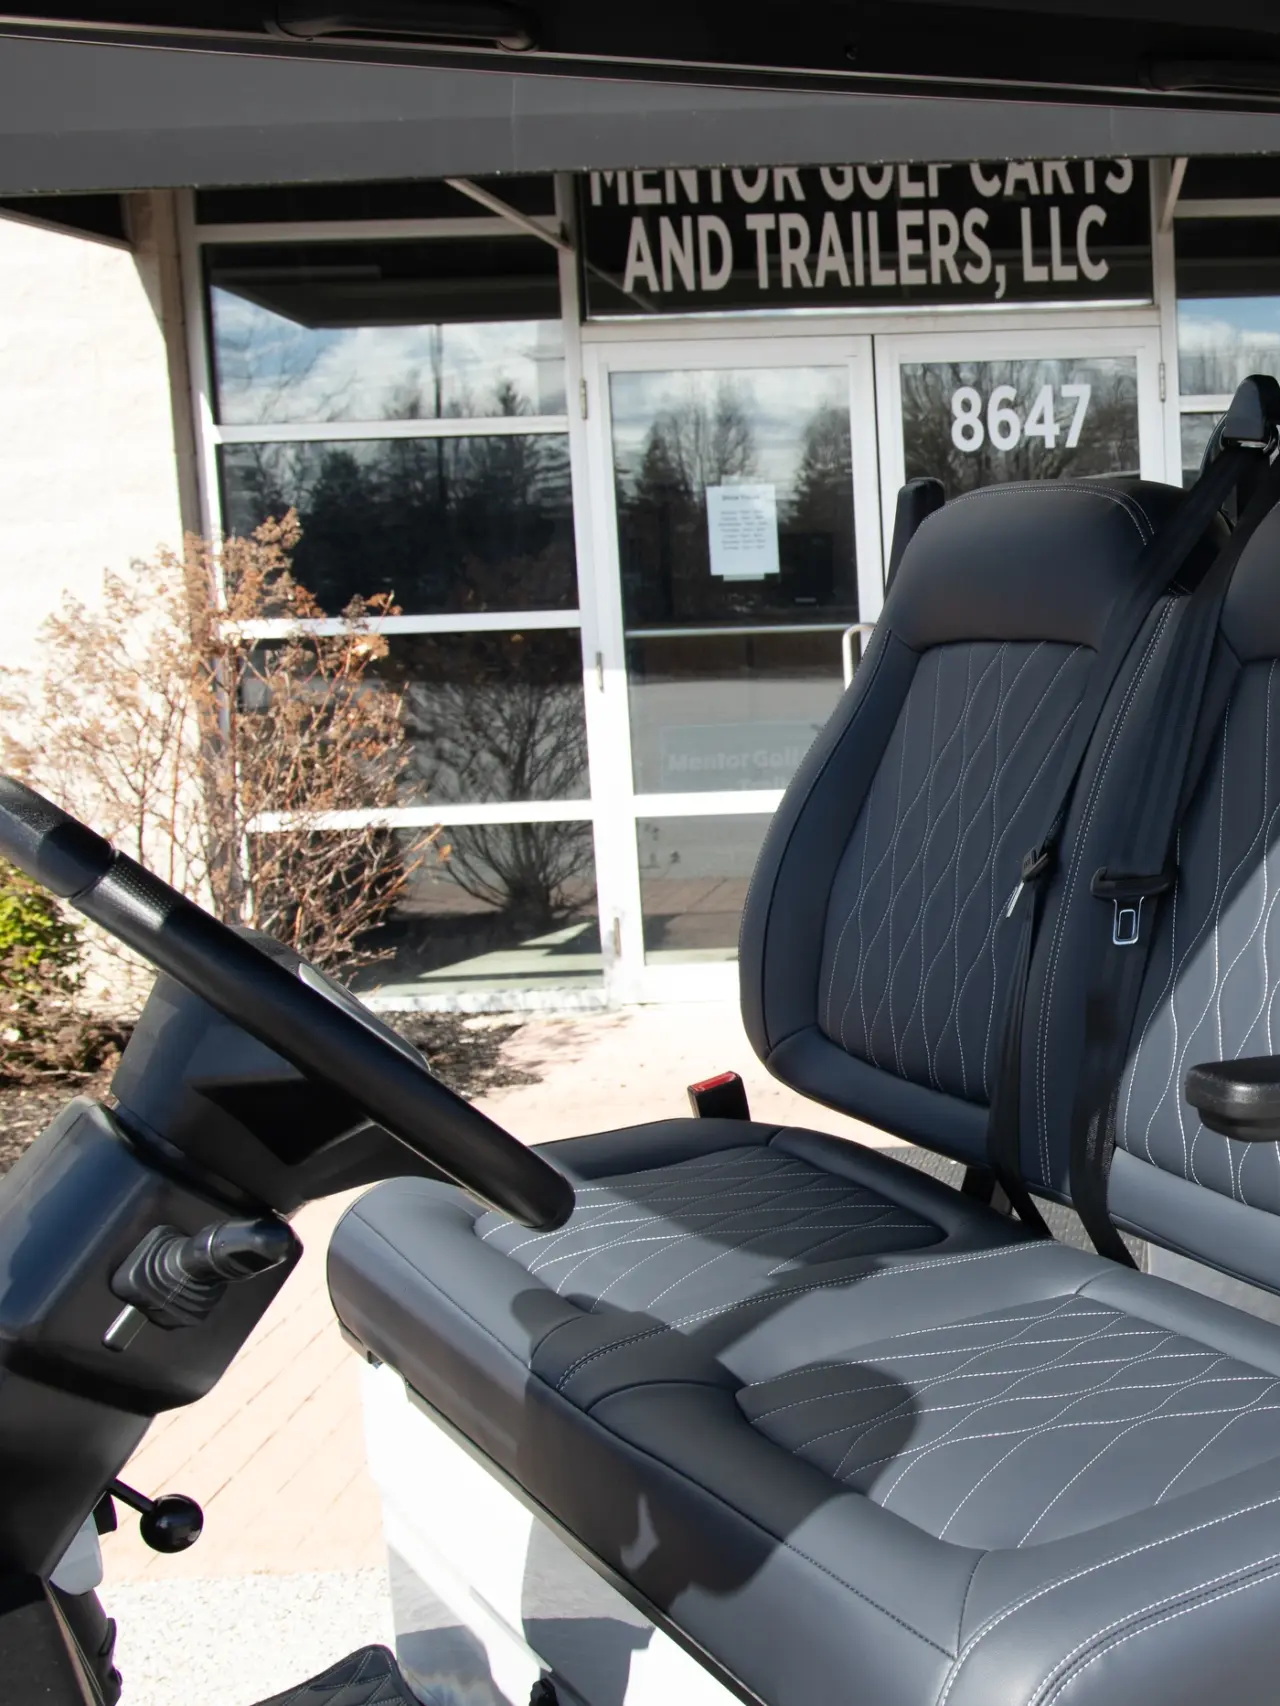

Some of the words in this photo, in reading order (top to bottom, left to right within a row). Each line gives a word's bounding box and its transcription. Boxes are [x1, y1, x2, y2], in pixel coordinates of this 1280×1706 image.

[623, 215, 733, 293] AND
[745, 207, 1006, 300] TRAILERS,
[1021, 204, 1110, 283] LLC
[951, 384, 1092, 453] 8647
[668, 752, 750, 771] Mentor
